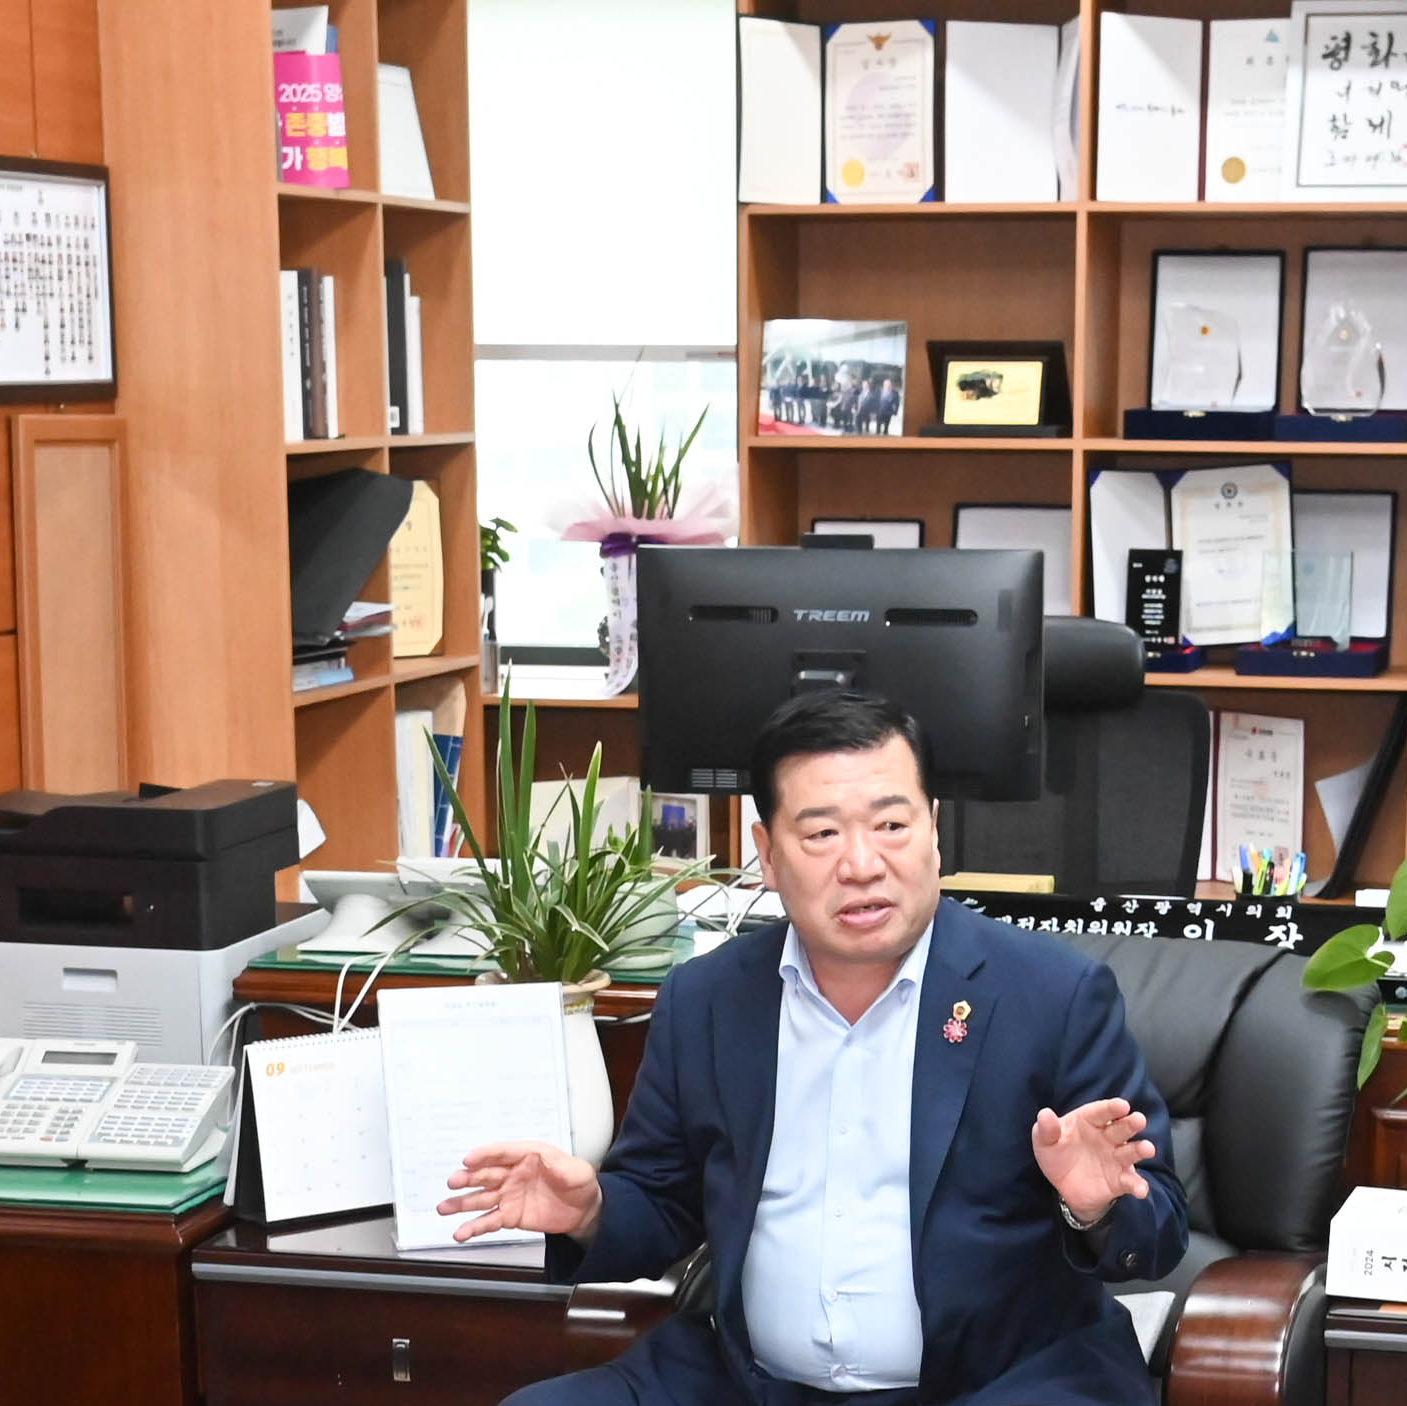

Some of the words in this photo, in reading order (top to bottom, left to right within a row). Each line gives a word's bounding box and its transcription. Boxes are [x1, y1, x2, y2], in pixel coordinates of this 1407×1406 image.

[278, 84, 323, 102] 2025
[793, 609, 870, 622] TREEM
[1090, 897, 1293, 920] 울산광역시의회
[266, 1062, 285, 1078] 09
[1364, 1249, 1374, 1276] 2024
